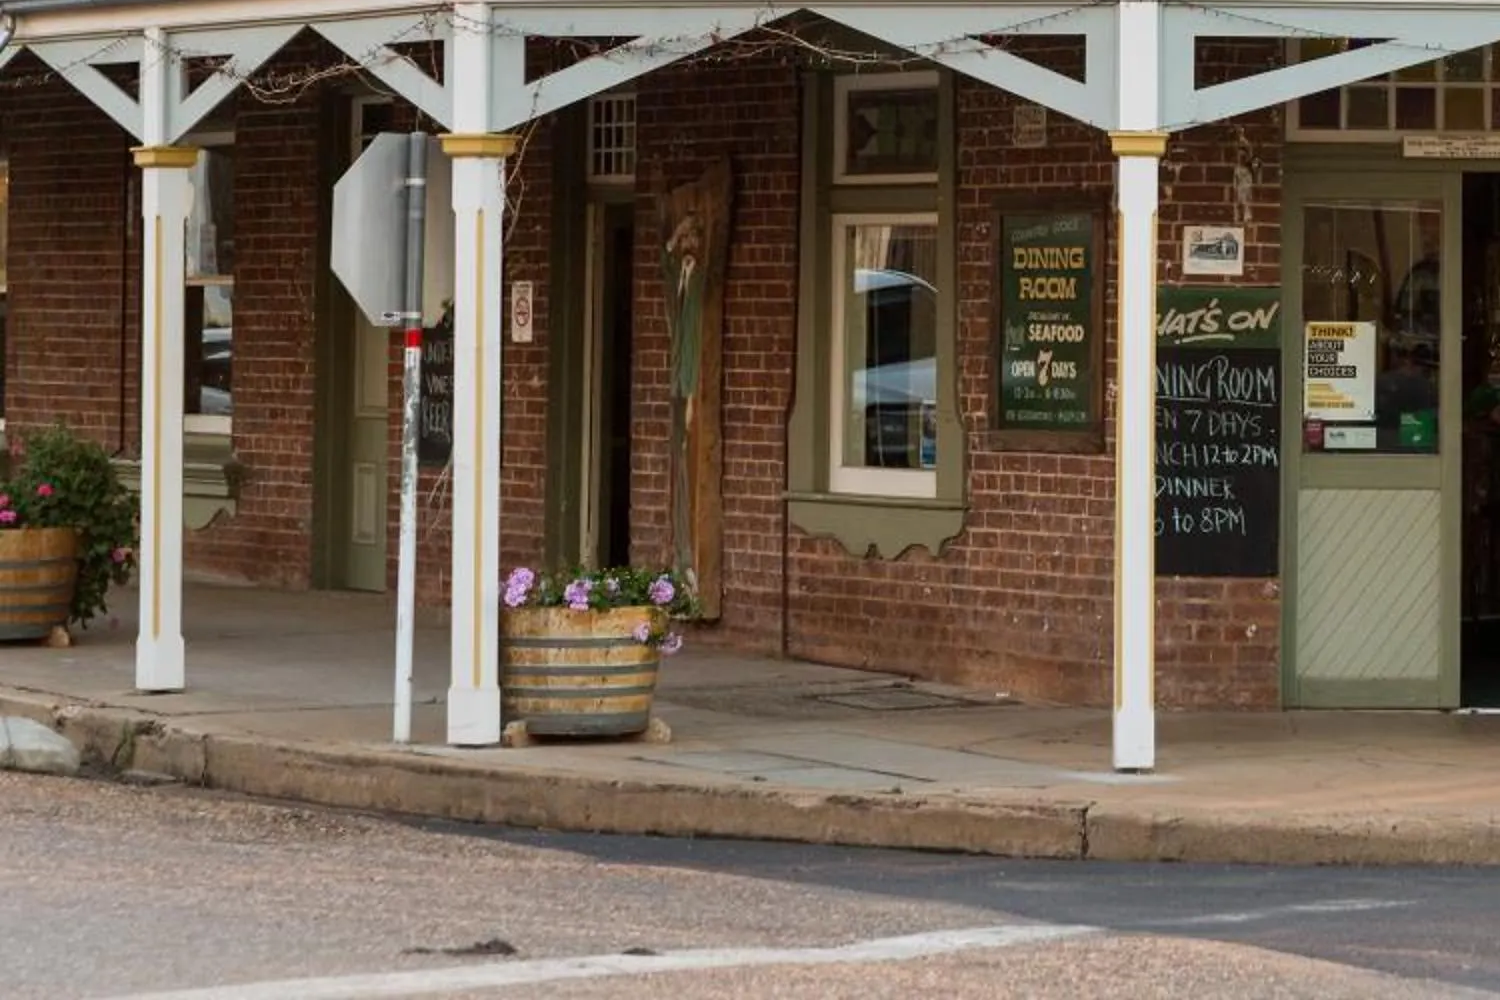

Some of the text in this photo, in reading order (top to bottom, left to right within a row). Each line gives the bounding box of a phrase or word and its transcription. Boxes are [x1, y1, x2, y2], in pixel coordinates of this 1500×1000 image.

[1013, 247, 1085, 269] DINING
[1019, 277, 1077, 300] ROOM
[1227, 301, 1280, 331] ON
[1028, 323, 1085, 342] SEAFOOD
[1311, 326, 1354, 338] THINK!
[1011, 349, 1077, 386] OPEN 7 DAYS
[1210, 355, 1277, 402] ROOM
[1309, 366, 1356, 377] CHOICES
[1184, 409, 1202, 433] 7
[1203, 443, 1221, 466] 12
[1221, 443, 1239, 464] to
[1240, 442, 1278, 467] 2PM
[1155, 476, 1236, 500] DINNER
[1172, 506, 1195, 533] to
[1200, 506, 1247, 536] 8PM
